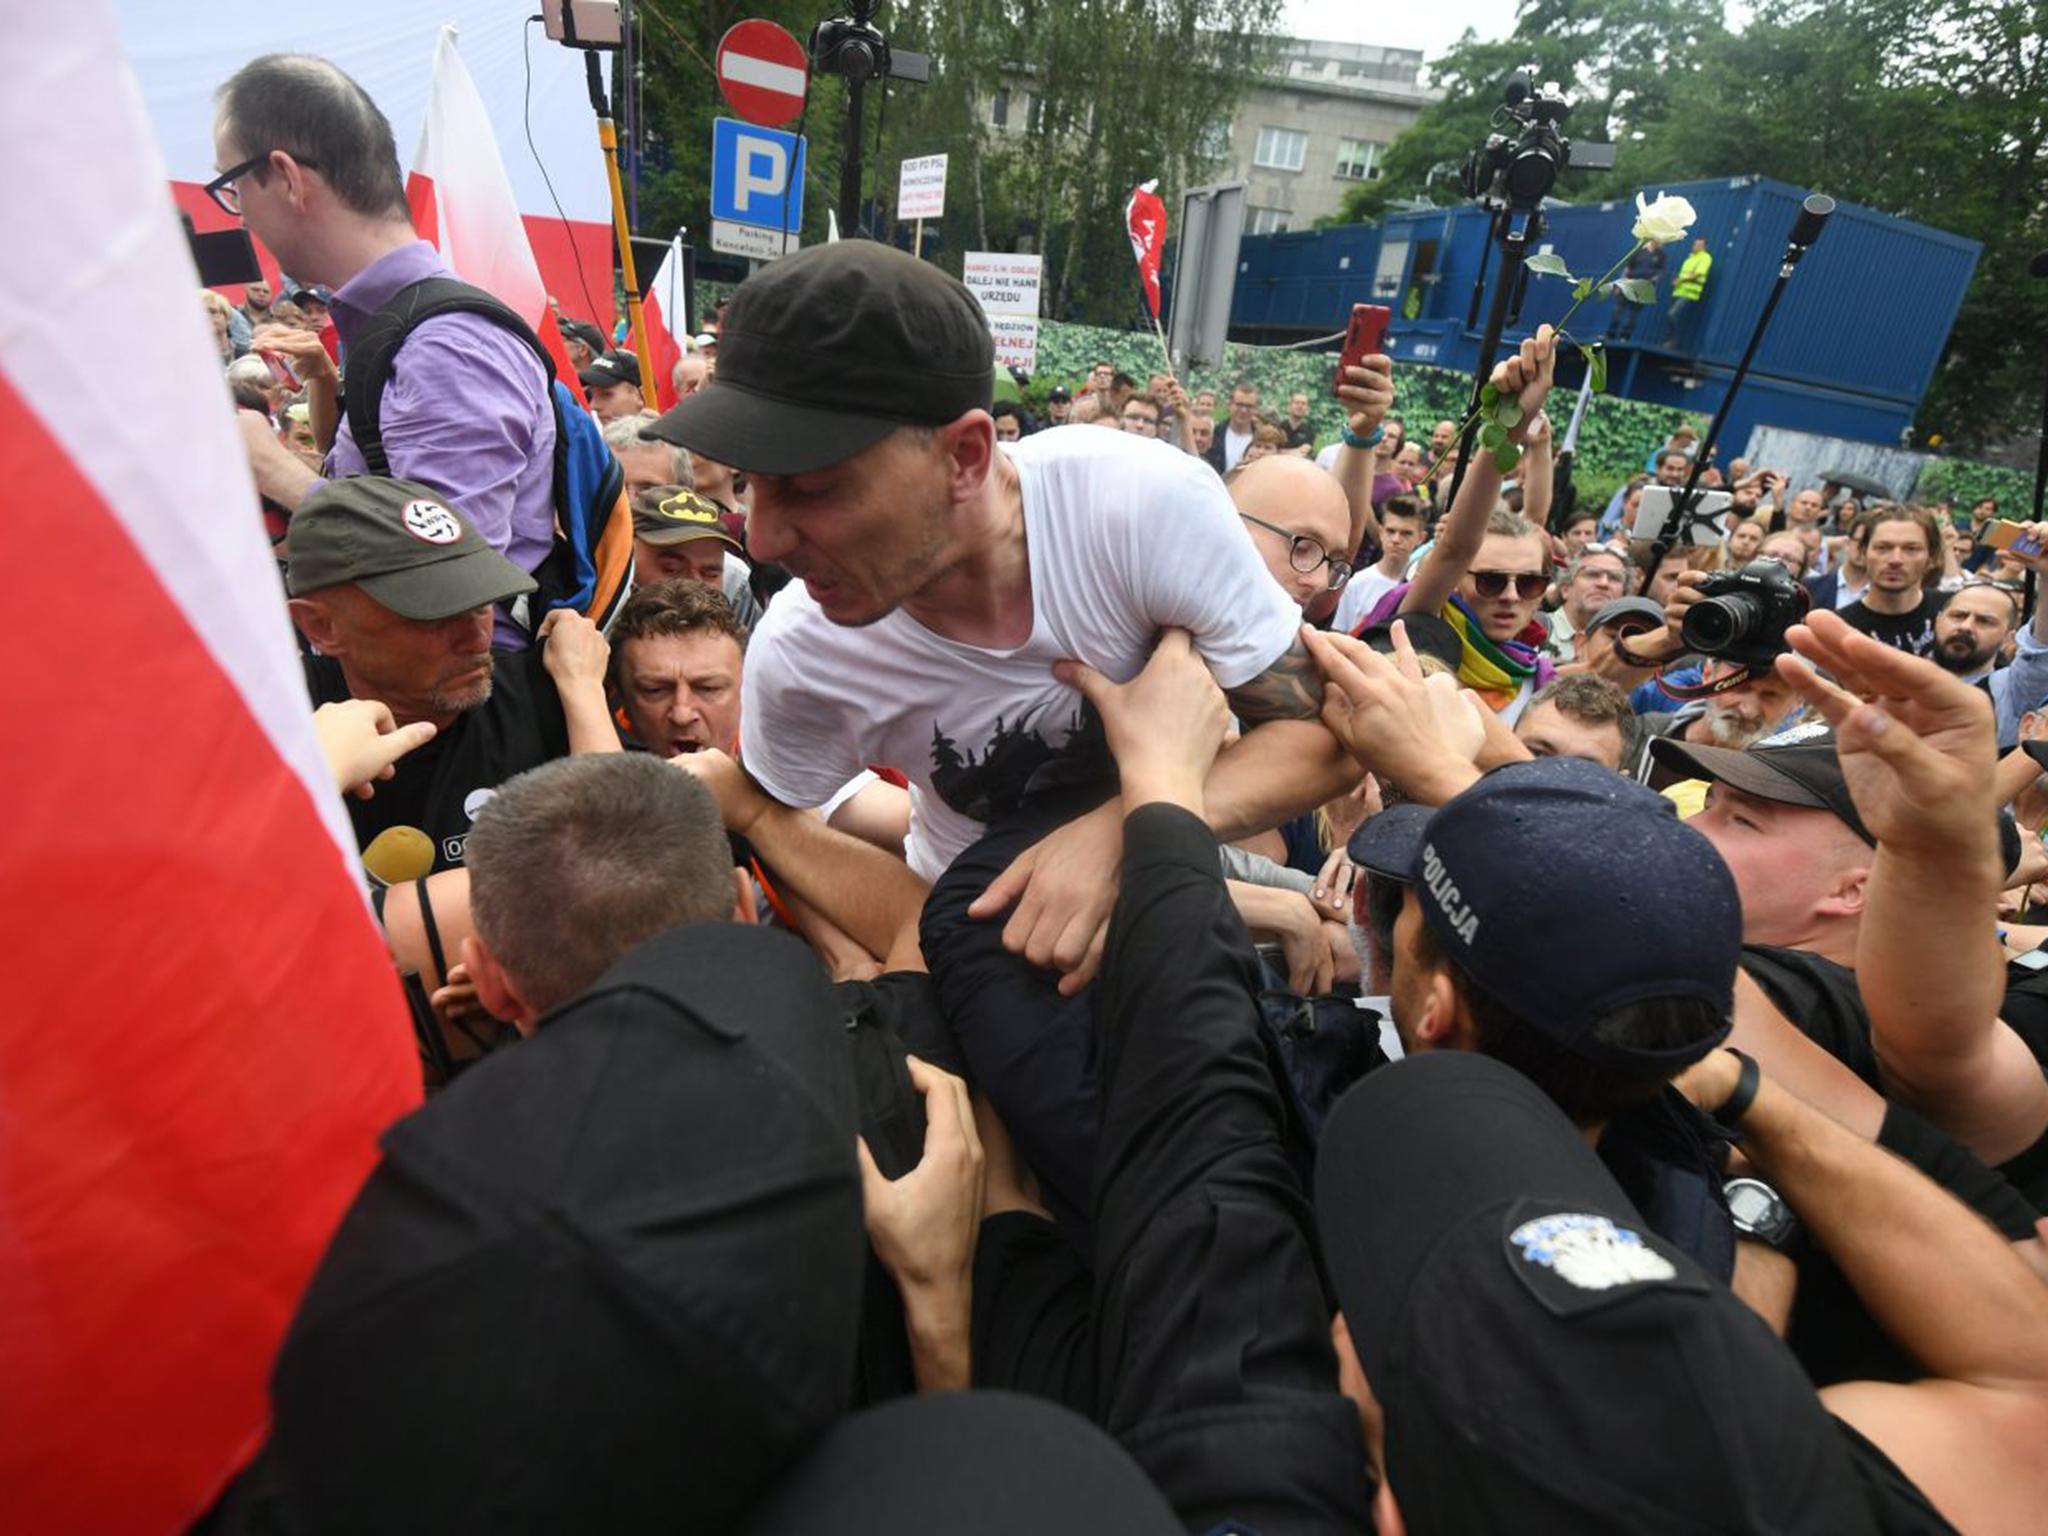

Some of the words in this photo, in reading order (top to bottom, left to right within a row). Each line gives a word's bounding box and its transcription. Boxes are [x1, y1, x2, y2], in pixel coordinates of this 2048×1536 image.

[734, 134, 787, 212] P
[738, 227, 774, 243] Parking
[966, 275, 993, 286] DALEJ
[995, 277, 1010, 287] NIE
[981, 290, 1021, 303] URZĘDU
[992, 336, 1034, 349] EŁNEJ
[1714, 669, 1749, 691] Canon
[1423, 842, 1480, 945] POLICJA
